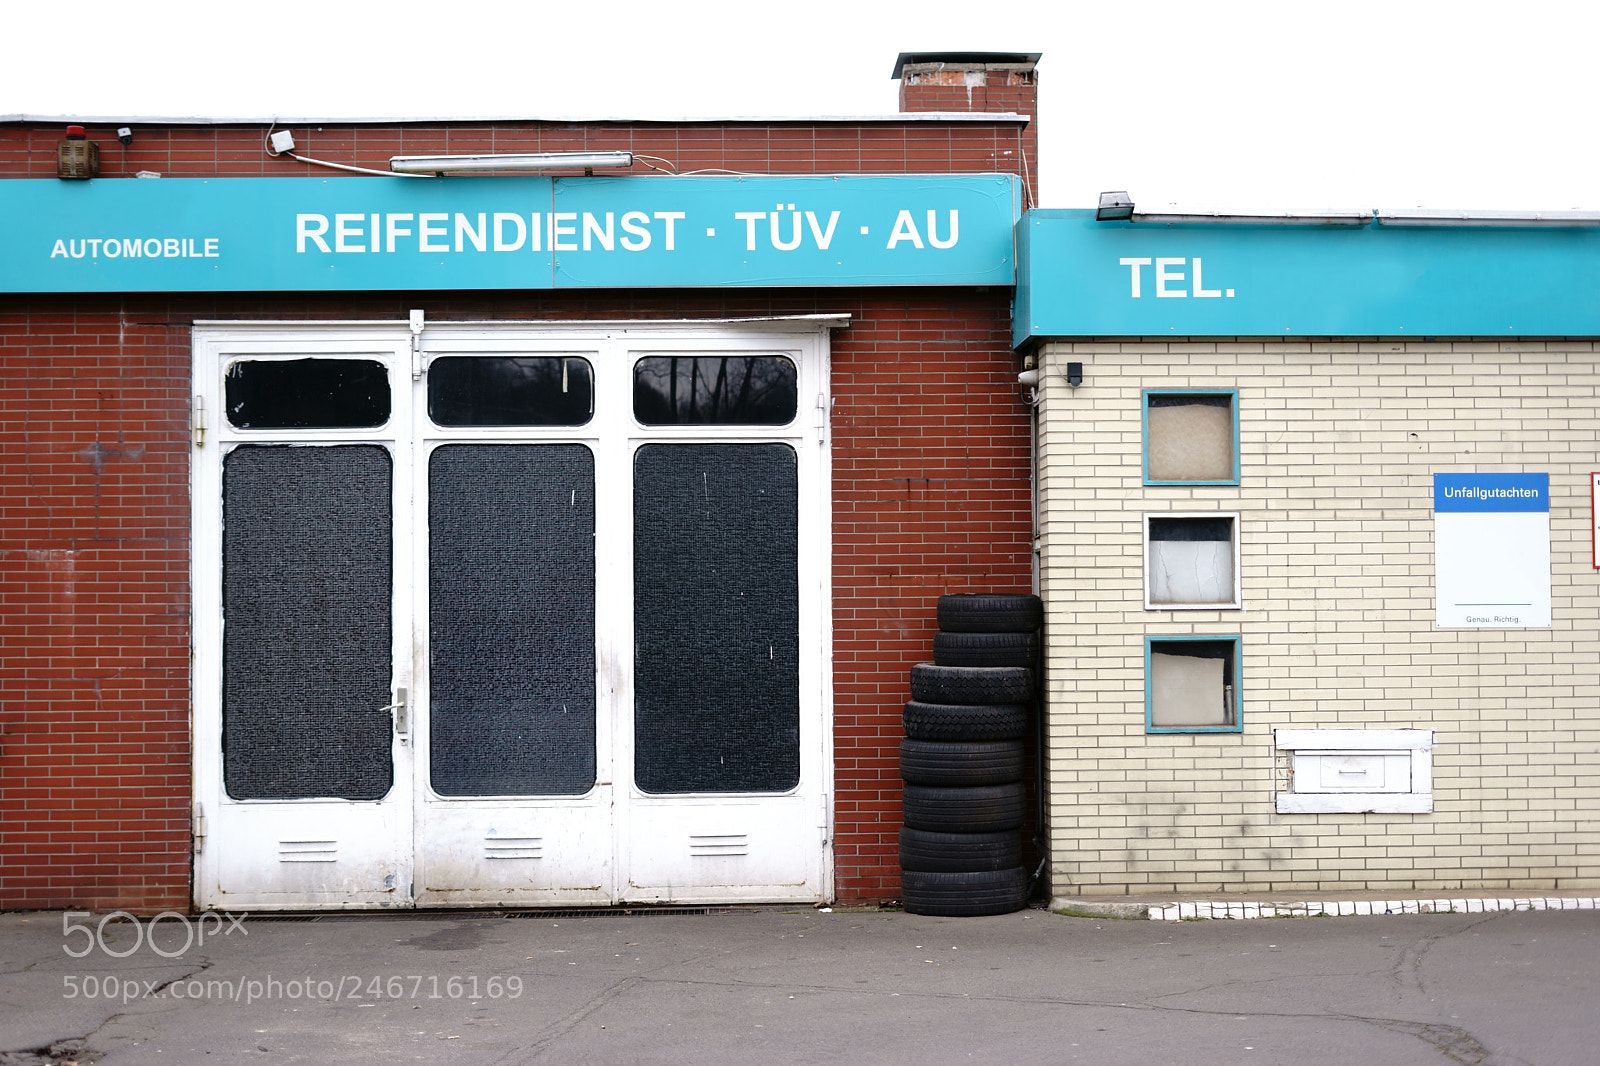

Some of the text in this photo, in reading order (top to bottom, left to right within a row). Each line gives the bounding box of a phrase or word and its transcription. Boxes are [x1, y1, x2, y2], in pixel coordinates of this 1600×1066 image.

[296, 202, 960, 253] REIFENDIENST TÜV AU
[50, 238, 220, 260] AUTOMOBILE
[1119, 256, 1236, 299] TEL.
[1444, 486, 1539, 500] Unfallgutachten
[1466, 615, 1521, 625] Genau. Richtig.
